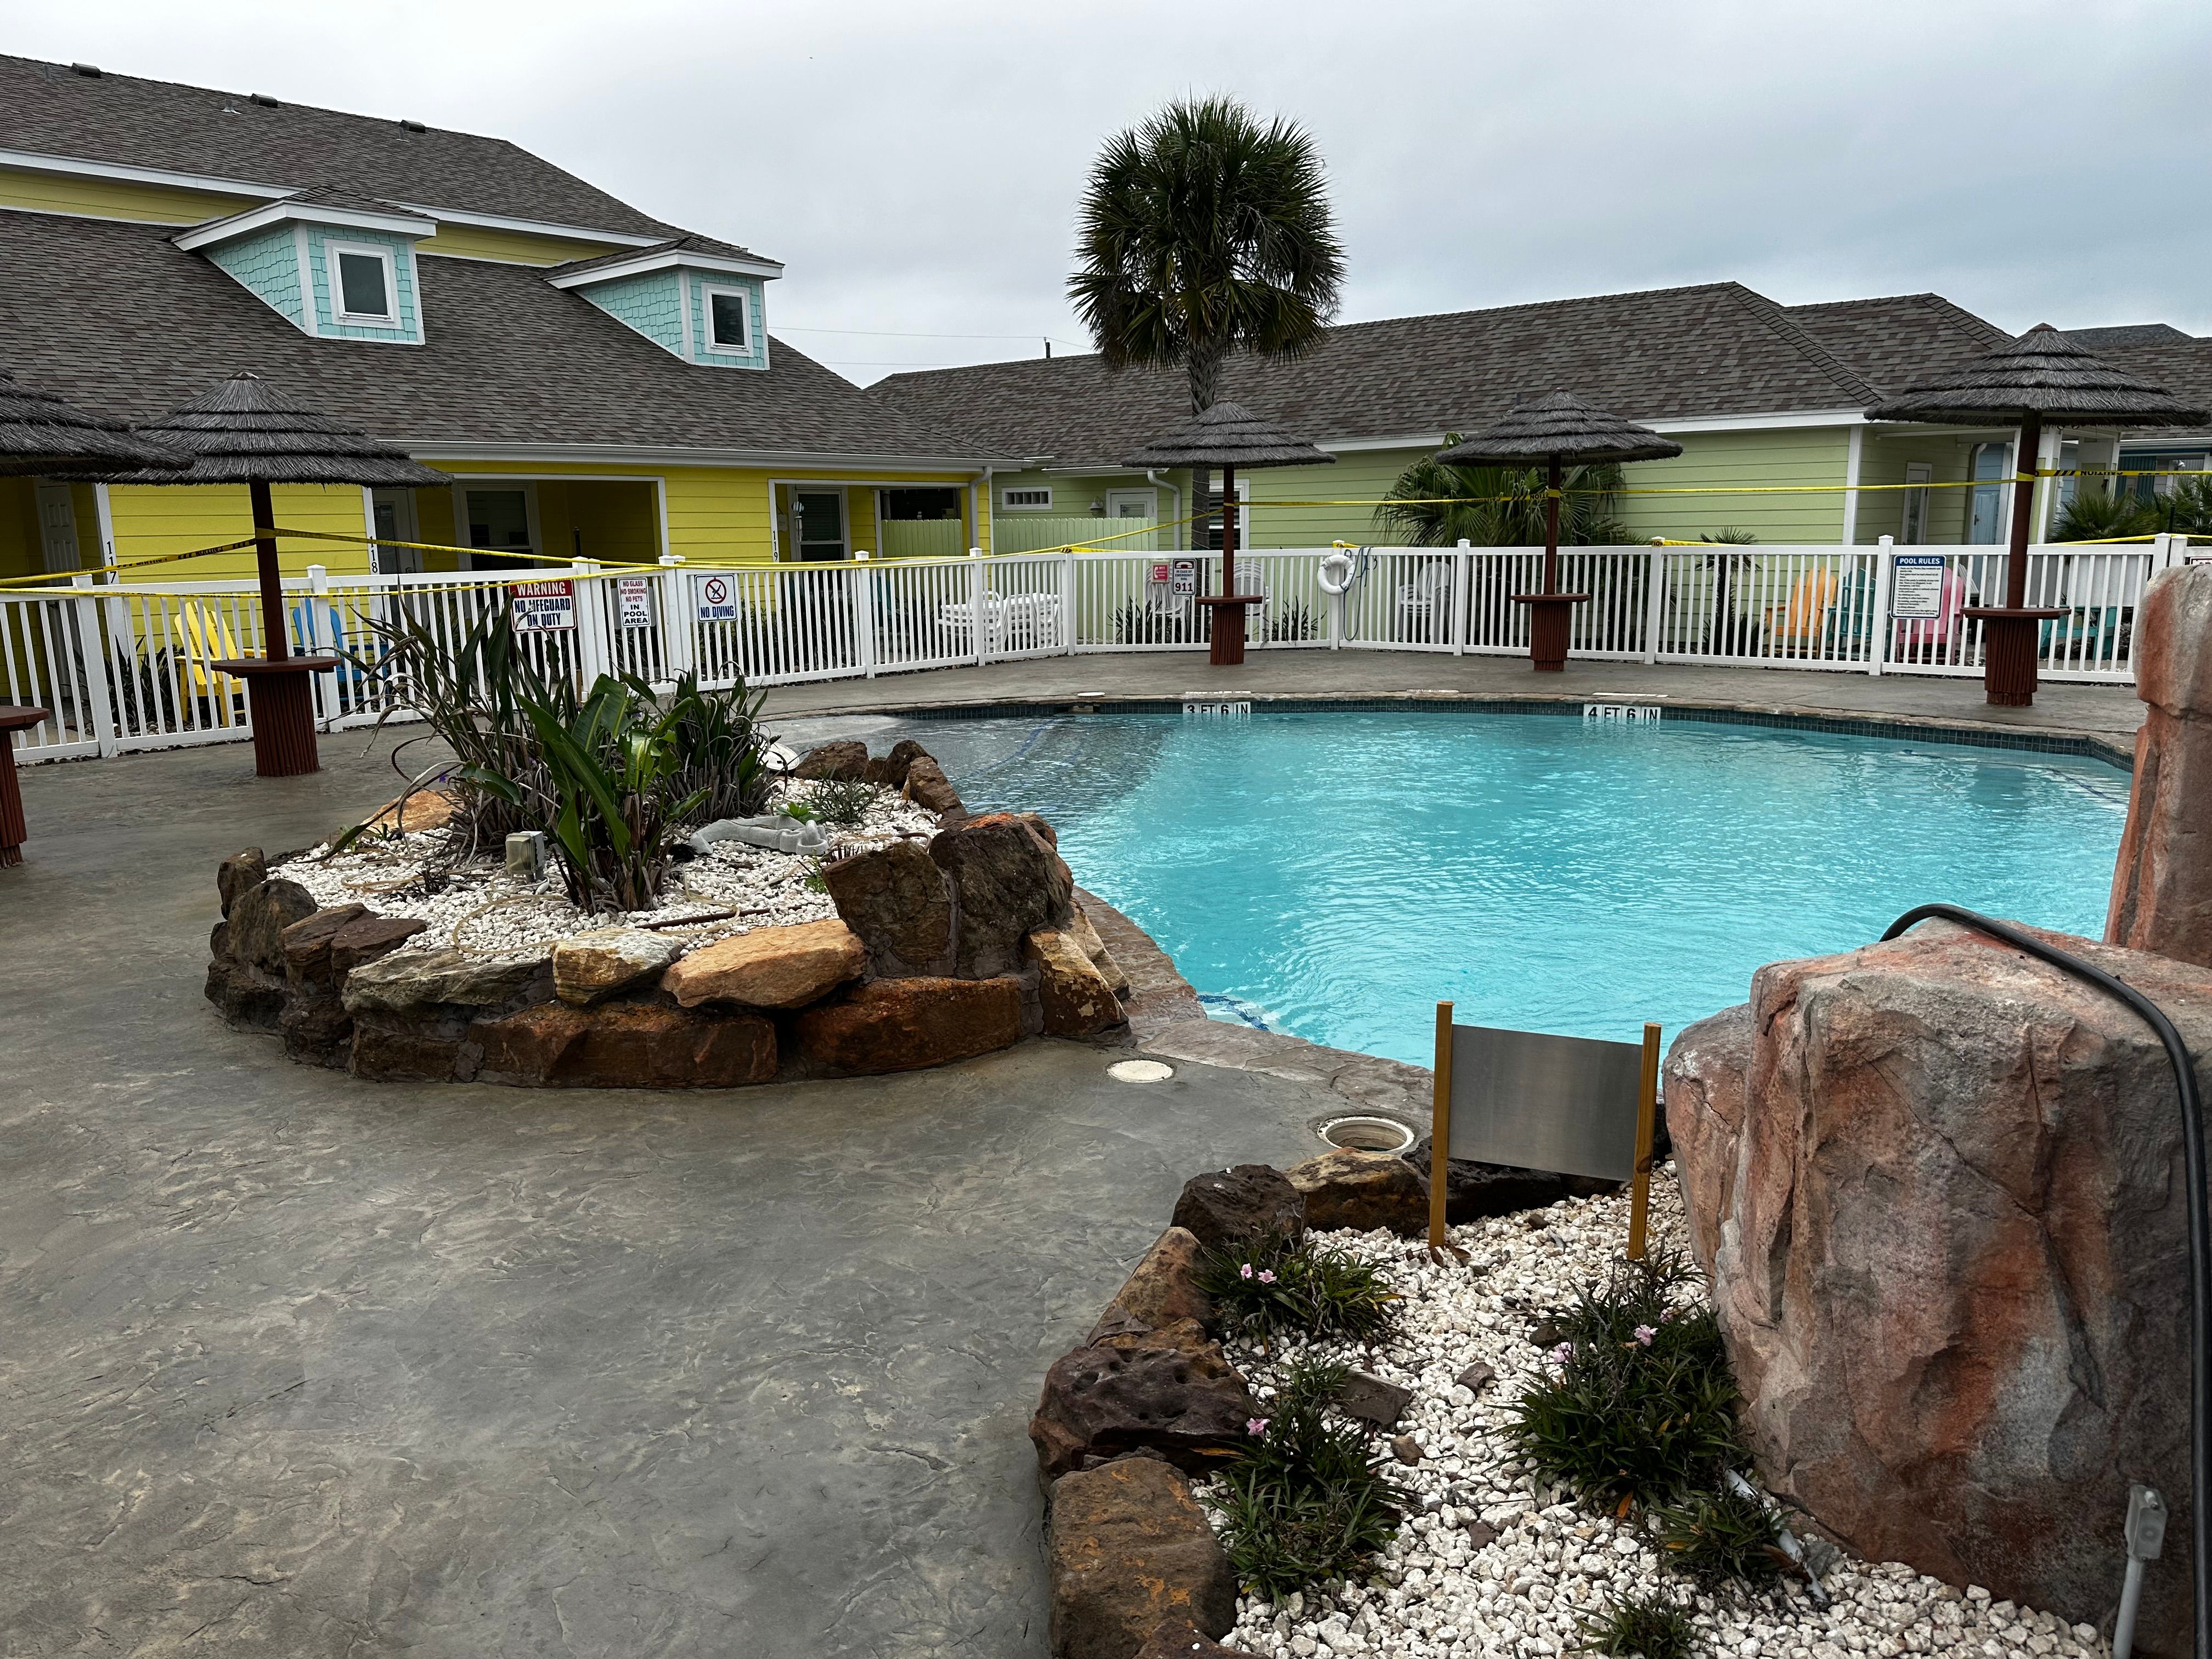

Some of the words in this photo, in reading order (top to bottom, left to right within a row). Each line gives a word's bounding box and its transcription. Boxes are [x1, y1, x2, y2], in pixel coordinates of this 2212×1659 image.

[370, 535, 378, 573] 118
[106, 541, 117, 583] 117
[517, 582, 566, 596] WARNING
[1175, 583, 1193, 591] 911
[514, 600, 526, 613] NO
[700, 607, 710, 618] NO
[712, 605, 734, 618] DIVING
[527, 614, 538, 627] ON
[541, 612, 561, 627] DUTY
[1187, 705, 1195, 714] 3
[1201, 704, 1215, 714] FT
[1221, 704, 1229, 714] 6
[1235, 704, 1248, 714] IN
[1588, 707, 1598, 716] 4
[1604, 707, 1620, 717] FT
[1627, 708, 1636, 718] 6
[1644, 709, 1657, 719] IN
